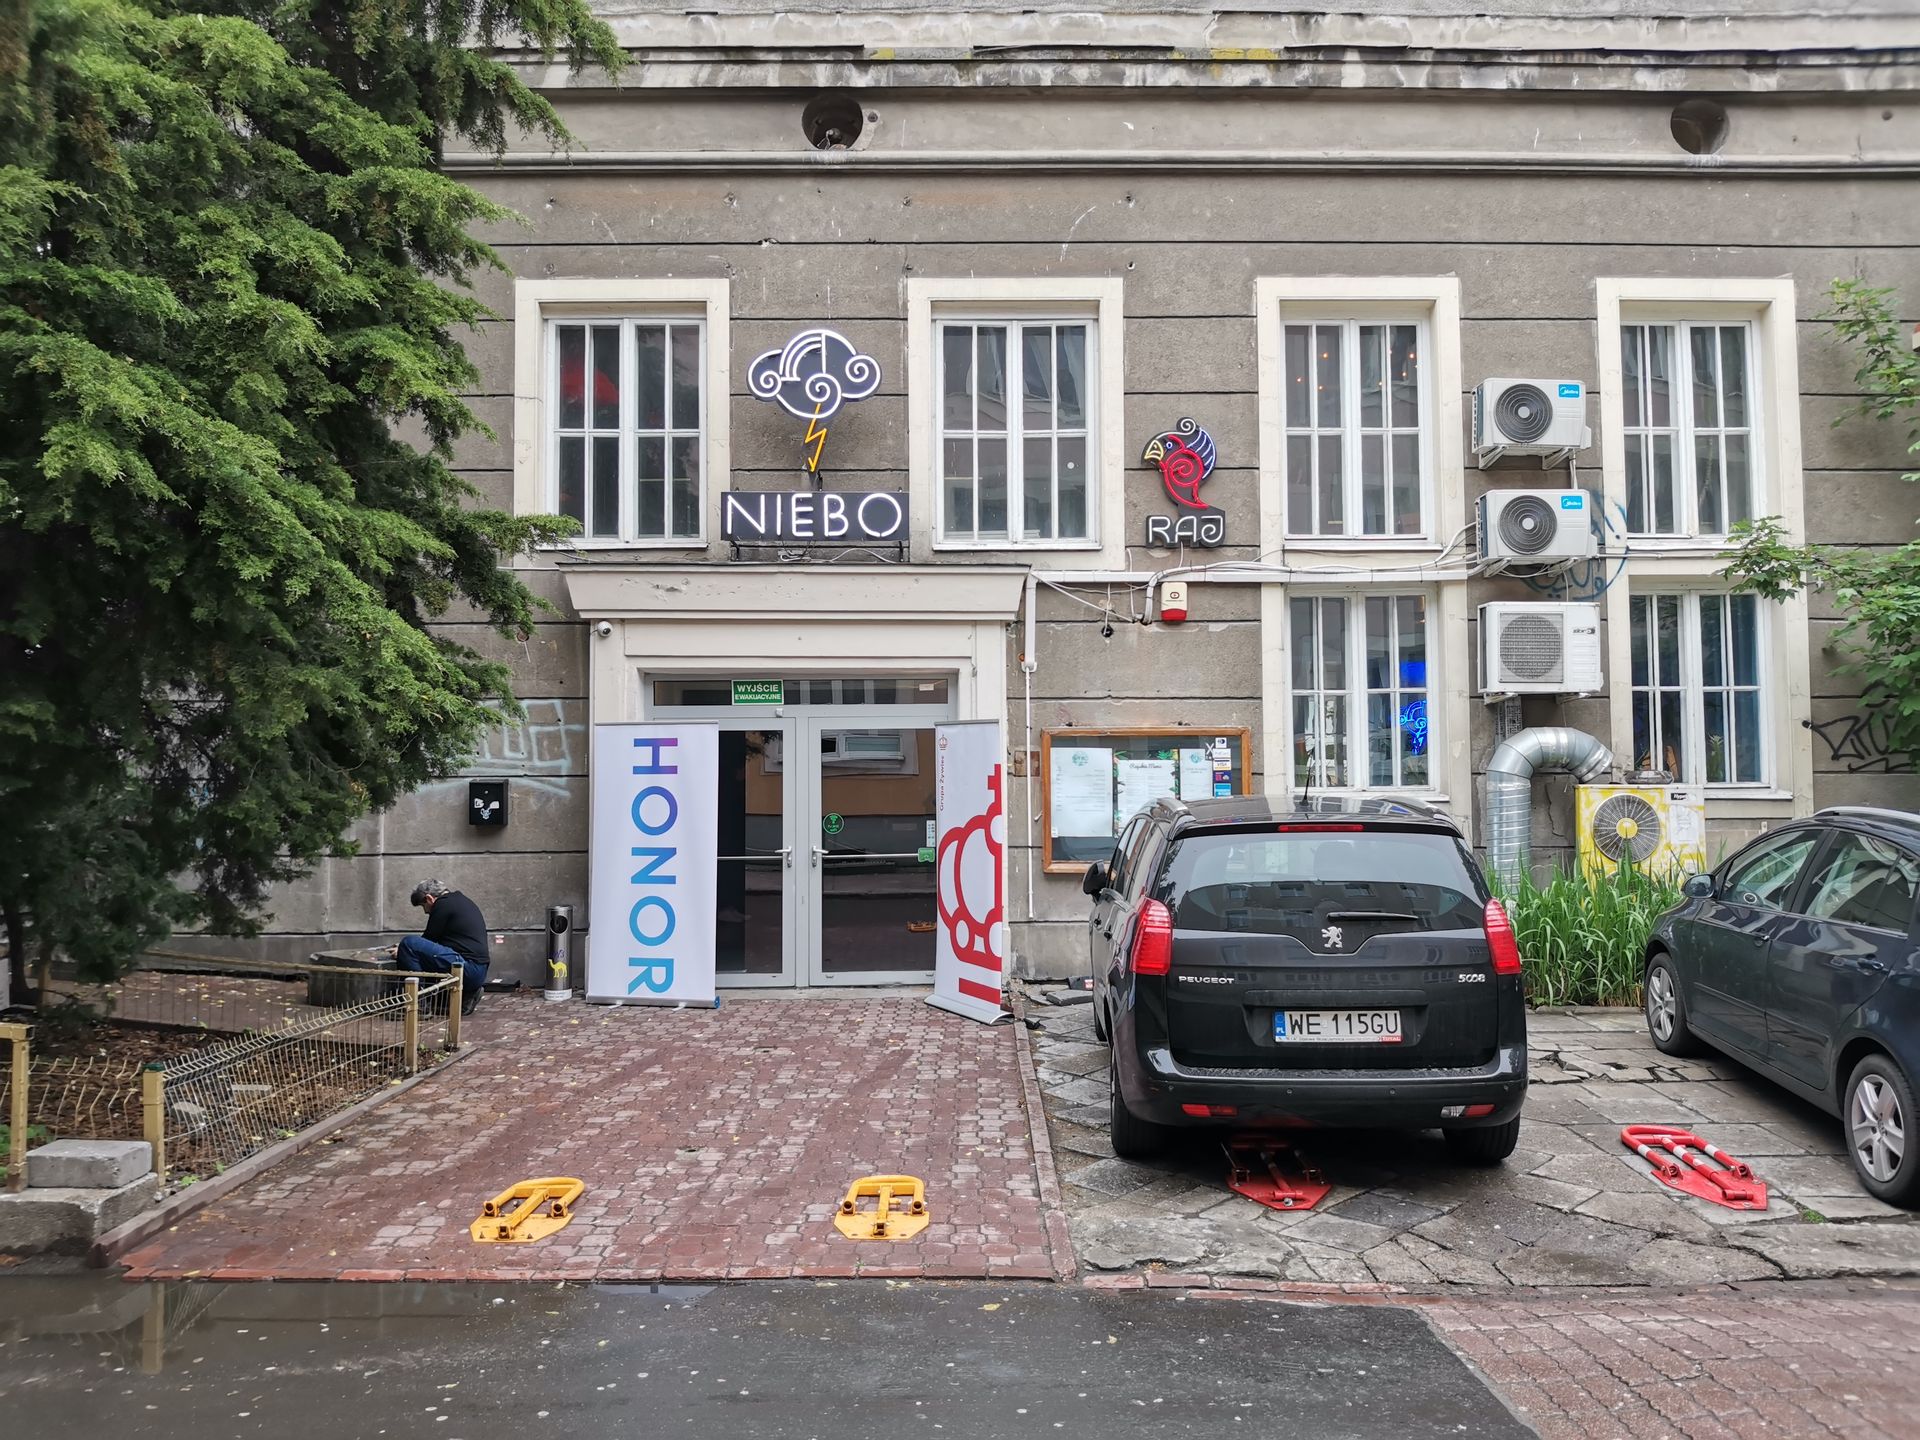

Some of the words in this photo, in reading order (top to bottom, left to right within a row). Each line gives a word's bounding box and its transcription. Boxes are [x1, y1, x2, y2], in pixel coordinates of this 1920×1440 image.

[727, 493, 902, 537] NIEBO
[1148, 515, 1224, 543] RAJ
[736, 682, 779, 692] WYJŚCIE
[627, 738, 679, 995] HONOR
[1178, 975, 1235, 984] PEUGEOT
[1457, 973, 1486, 983] 5008
[1288, 1013, 1321, 1035] WE
[1331, 1012, 1399, 1035] 115GU
